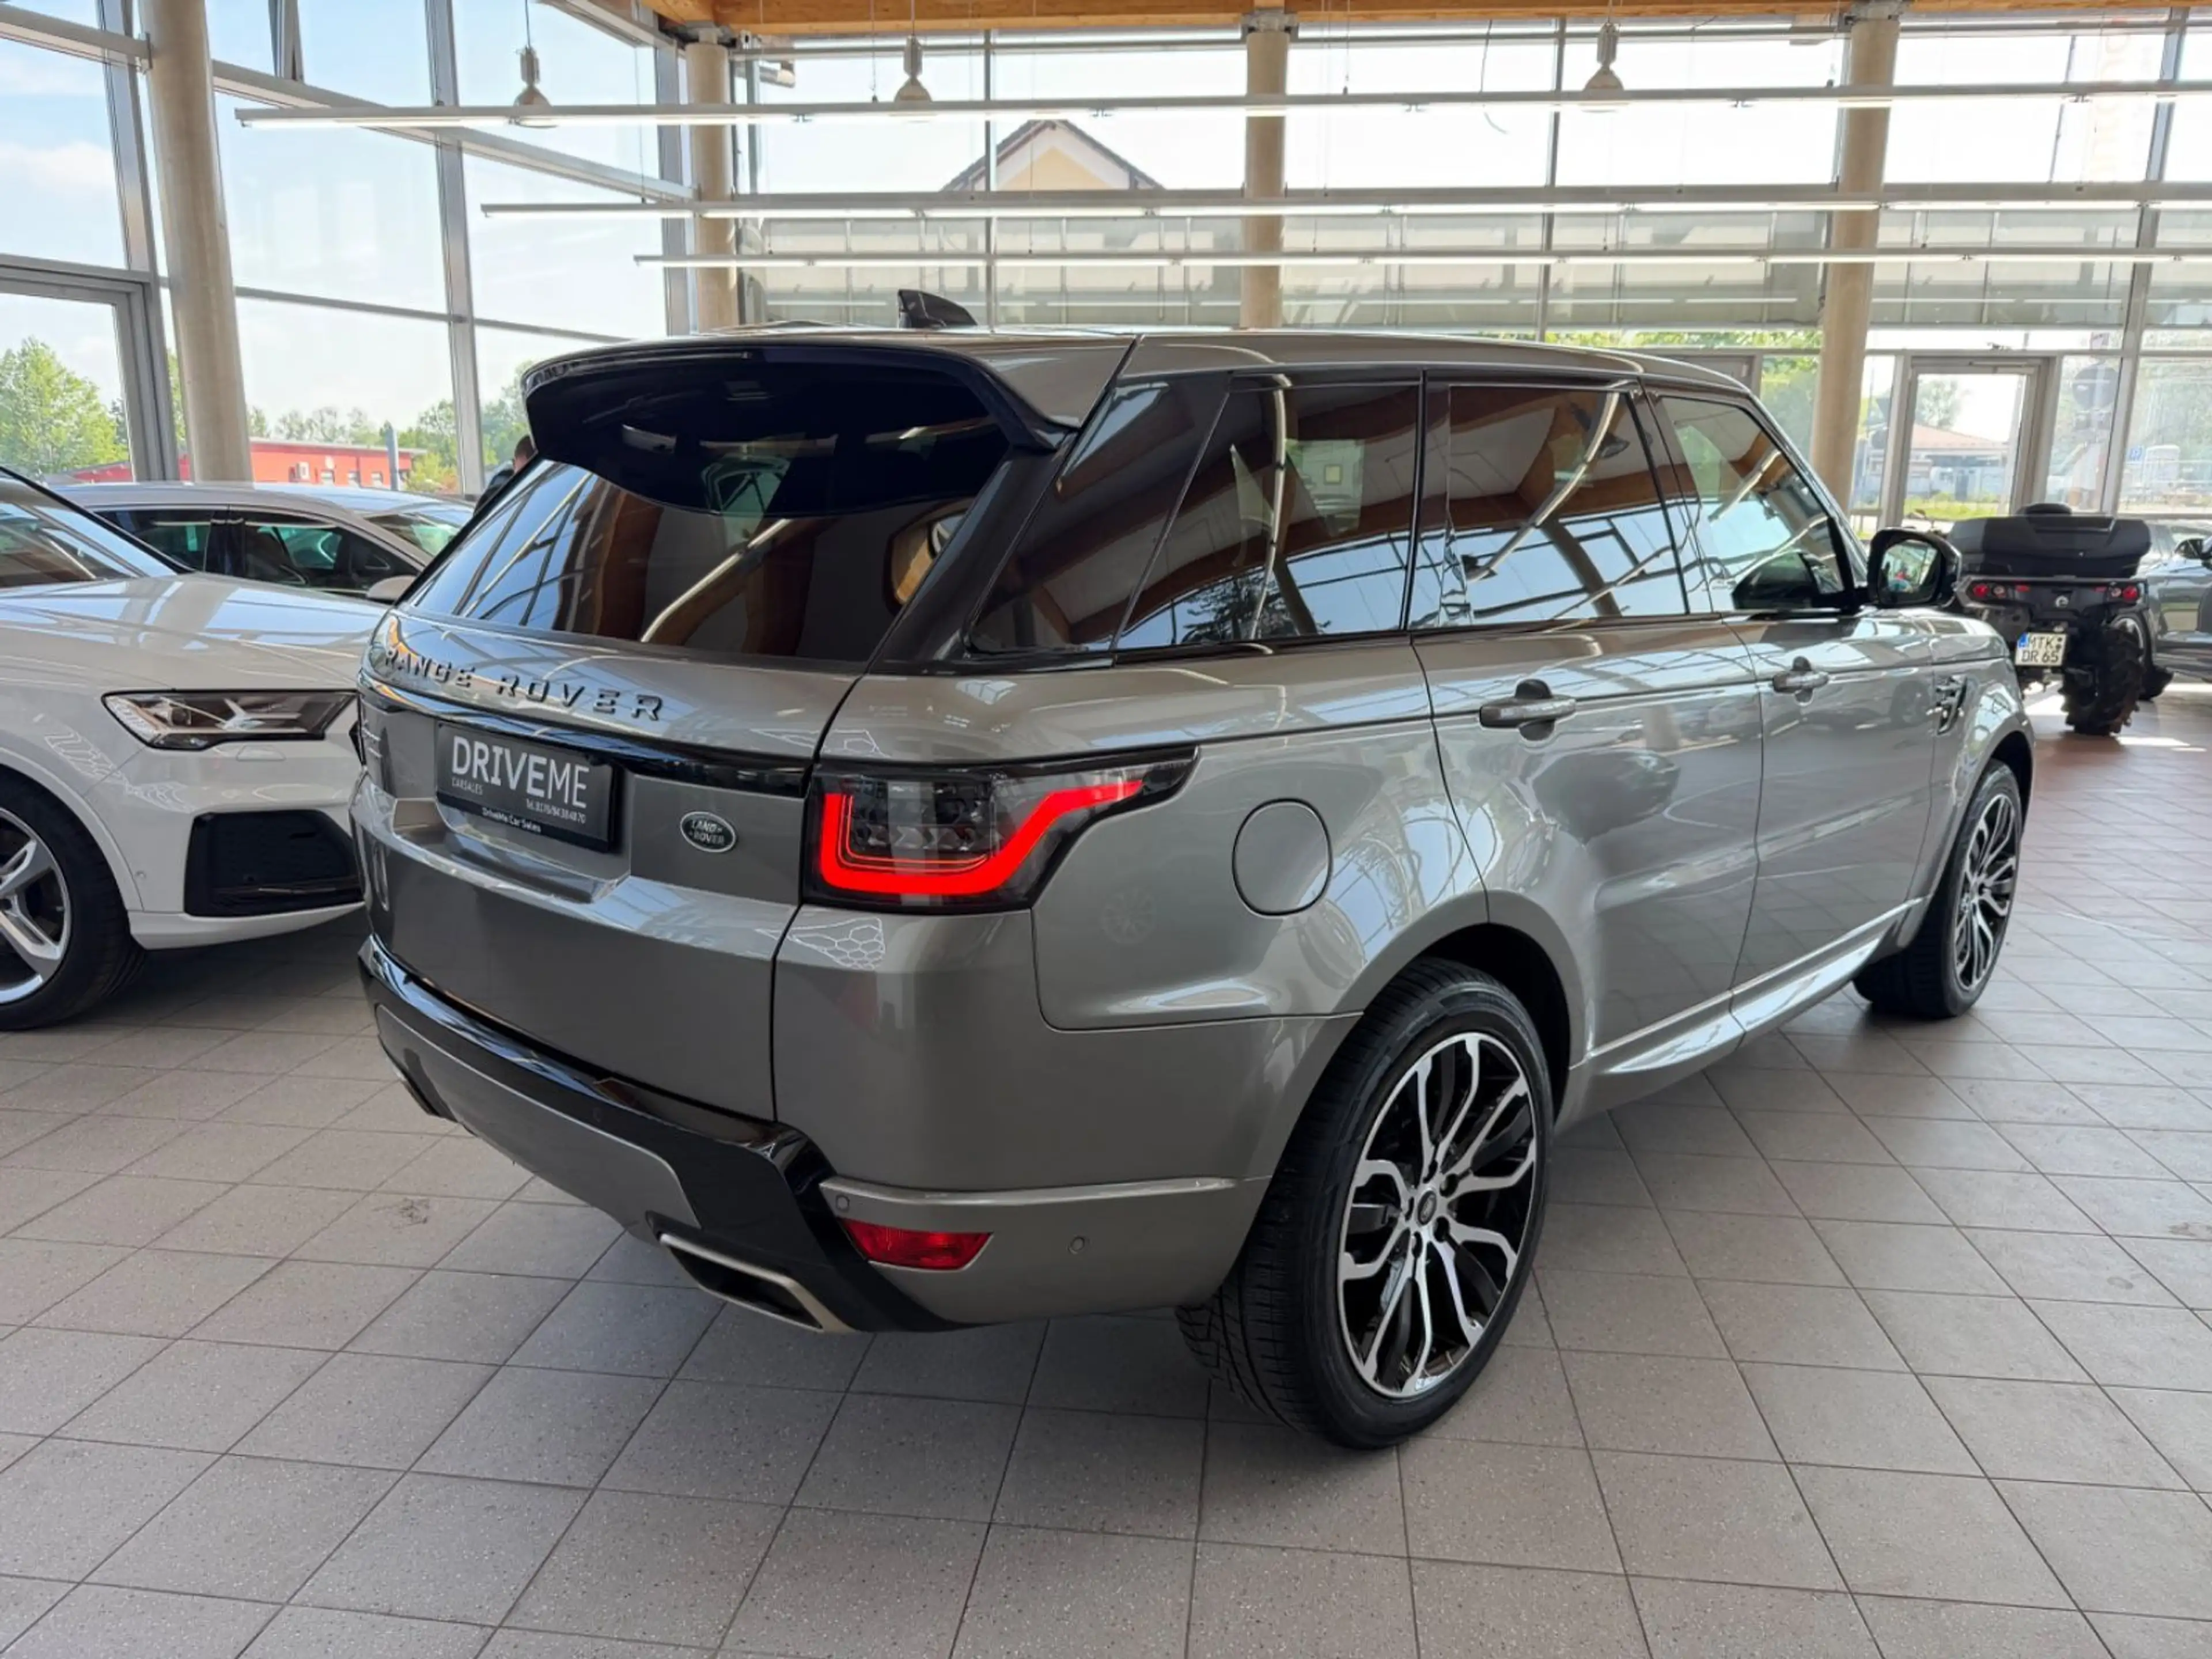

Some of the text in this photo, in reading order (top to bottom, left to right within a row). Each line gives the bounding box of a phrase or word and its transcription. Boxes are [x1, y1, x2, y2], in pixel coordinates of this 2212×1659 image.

[2021, 650, 2039, 662] DR
[385, 646, 663, 721] RANGE ROVER
[452, 736, 589, 809] DRIVEME
[692, 819, 718, 832] LAND
[694, 830, 725, 844] ROVER
